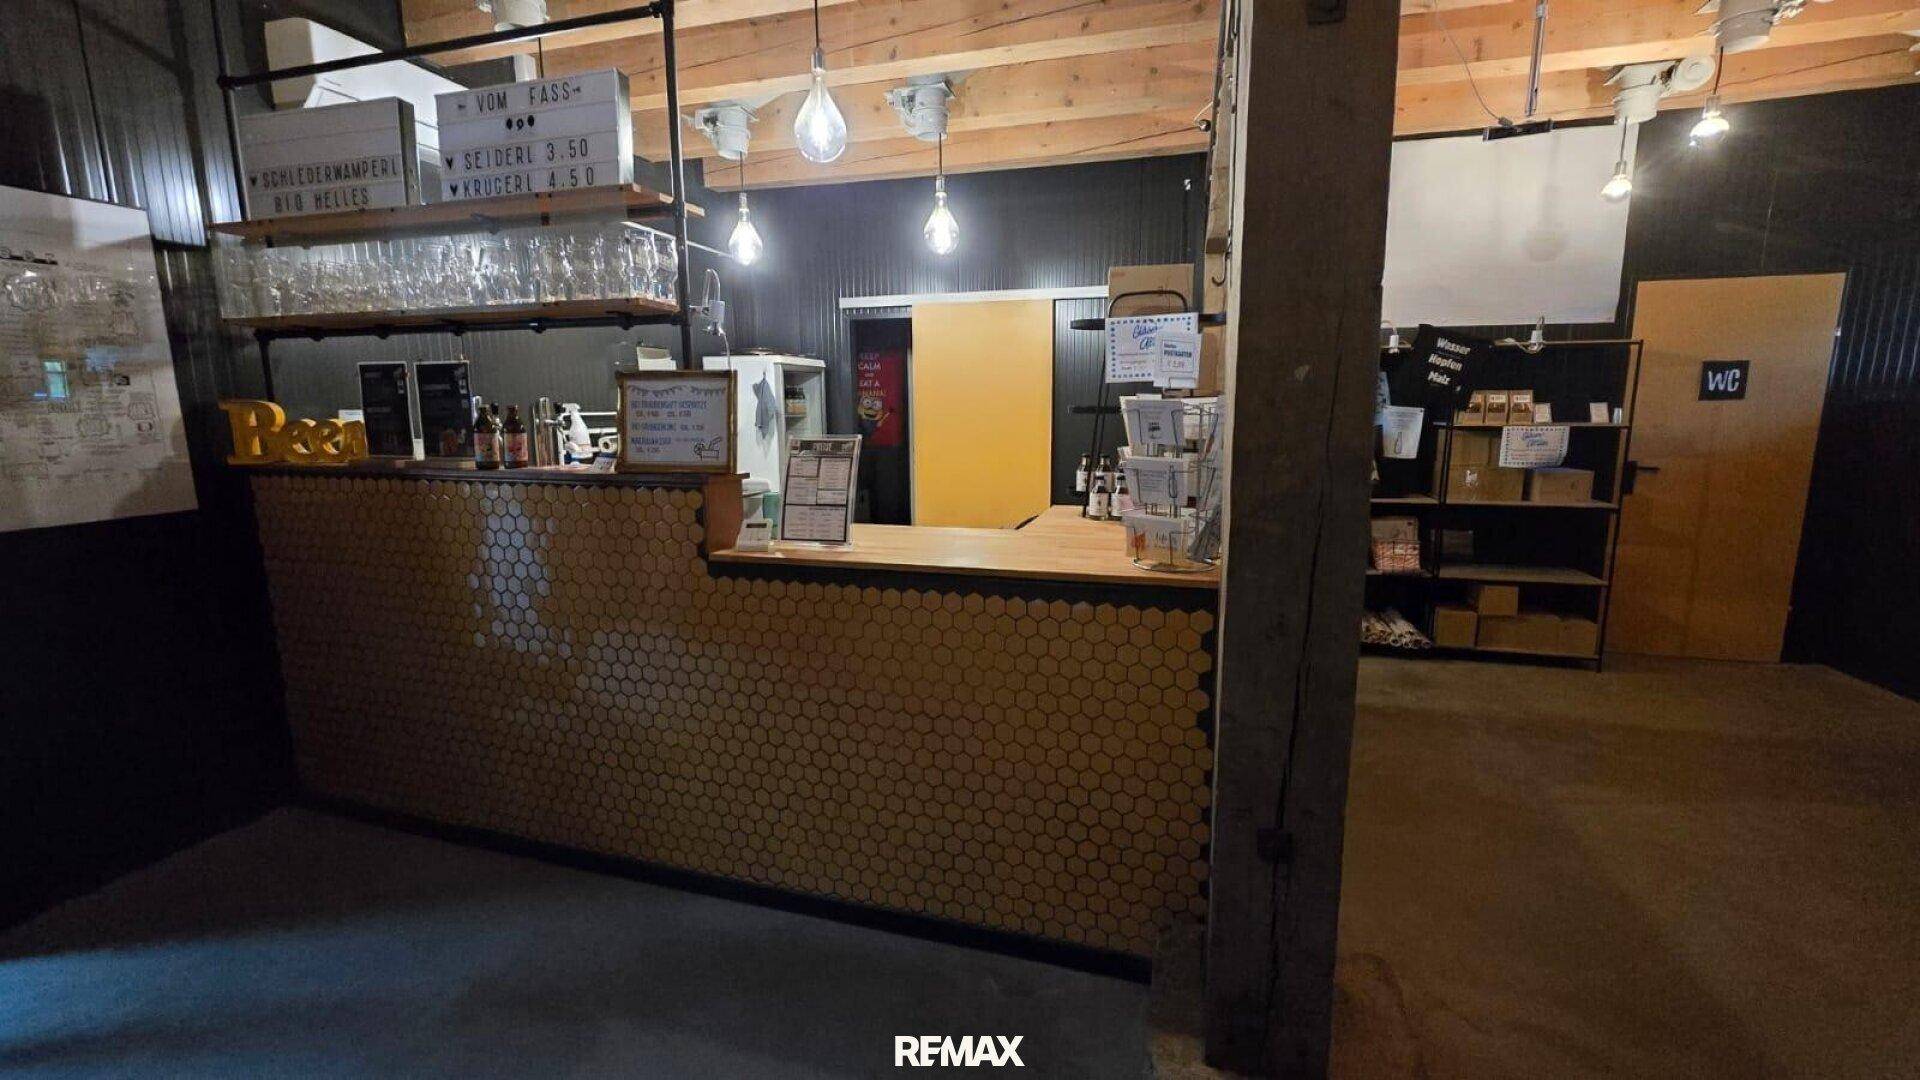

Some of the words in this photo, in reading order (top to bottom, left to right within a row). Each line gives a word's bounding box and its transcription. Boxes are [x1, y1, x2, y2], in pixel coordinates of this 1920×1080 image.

[476, 91, 508, 112] VOM
[529, 82, 570, 106] FASS
[464, 146, 533, 171] SEIDERL
[547, 138, 588, 162] 3.50
[549, 166, 594, 190] 4.50
[314, 187, 369, 210] HELLES
[858, 361, 882, 371] CALM
[1707, 368, 1741, 392] WC
